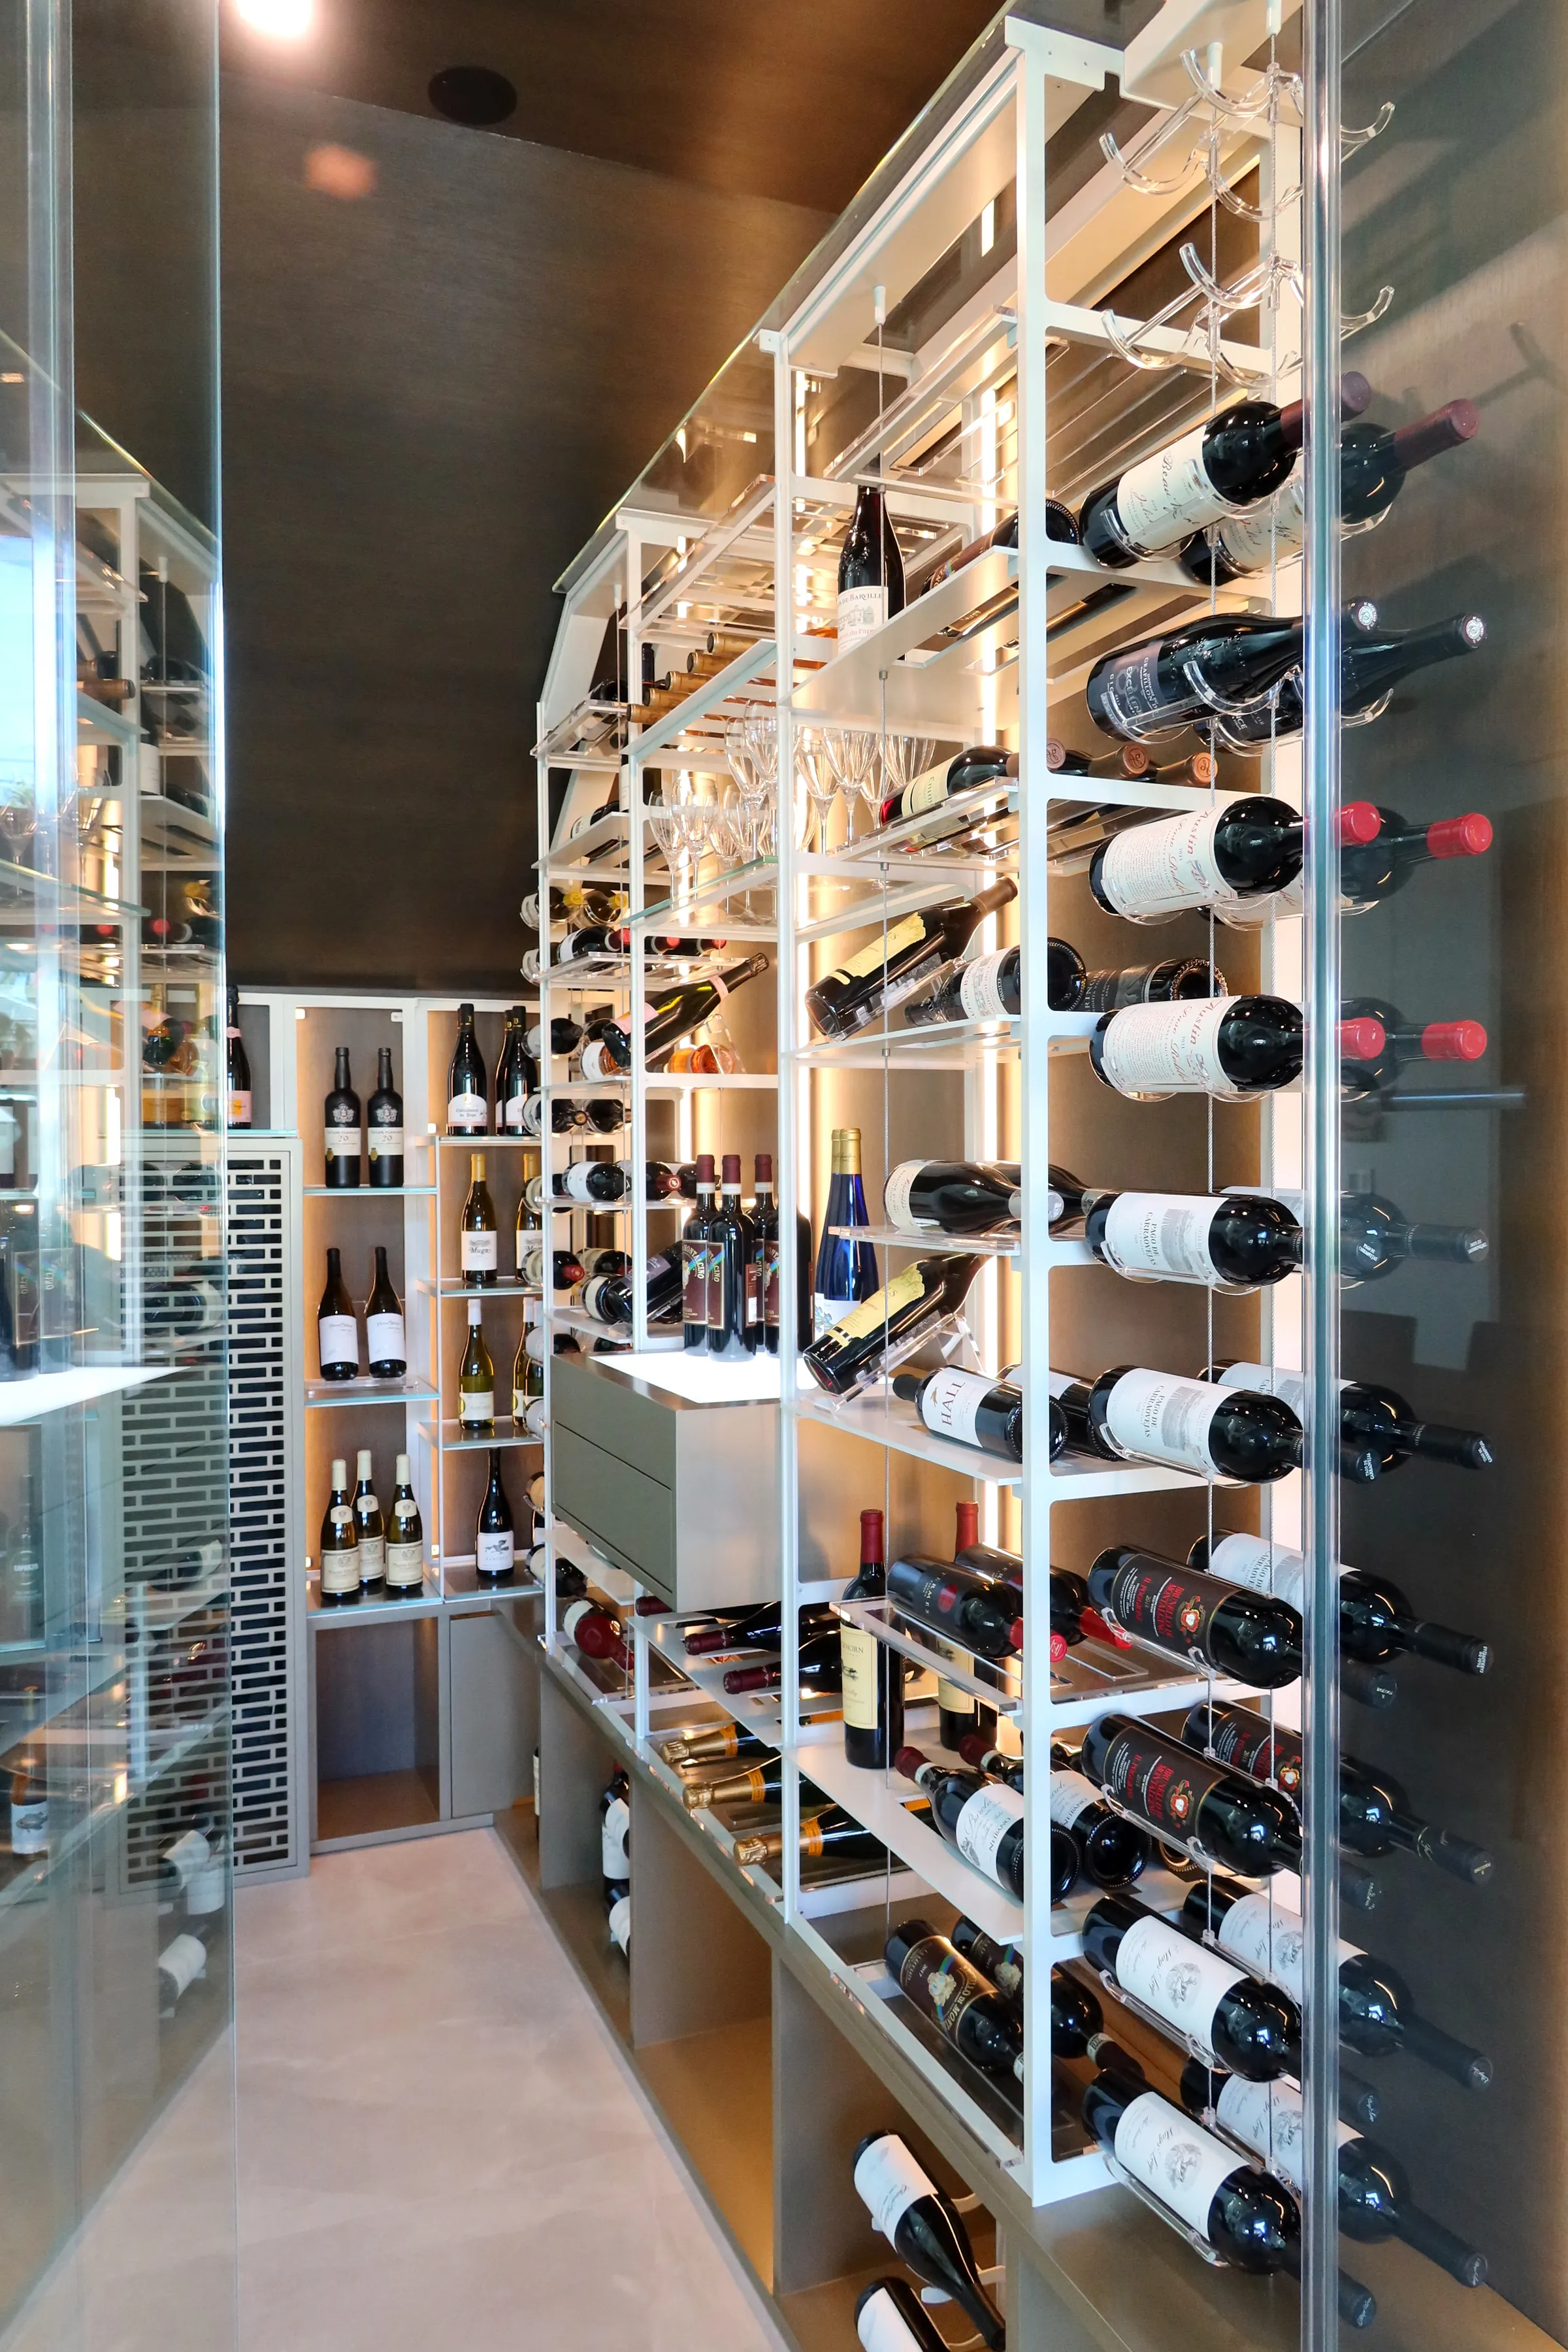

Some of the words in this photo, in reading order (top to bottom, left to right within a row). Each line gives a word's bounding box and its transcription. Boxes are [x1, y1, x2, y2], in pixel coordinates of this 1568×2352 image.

[1188, 808, 1217, 855] Austin
[1190, 1000, 1223, 1045] Austin
[1143, 1212, 1158, 1266] CARRAOVEJAS
[1152, 1247, 1160, 1256] DE
[941, 1382, 966, 1426] HALL
[1143, 1385, 1164, 1438] CARRAOVEJAS
[1151, 1418, 1158, 1428] DE
[1153, 1394, 1165, 1419] PAGO
[1156, 1582, 1177, 1635] MONTALCINO
[1165, 1586, 1184, 1628] BRUNELLO
[1147, 1763, 1167, 1816] MONTALCINO
